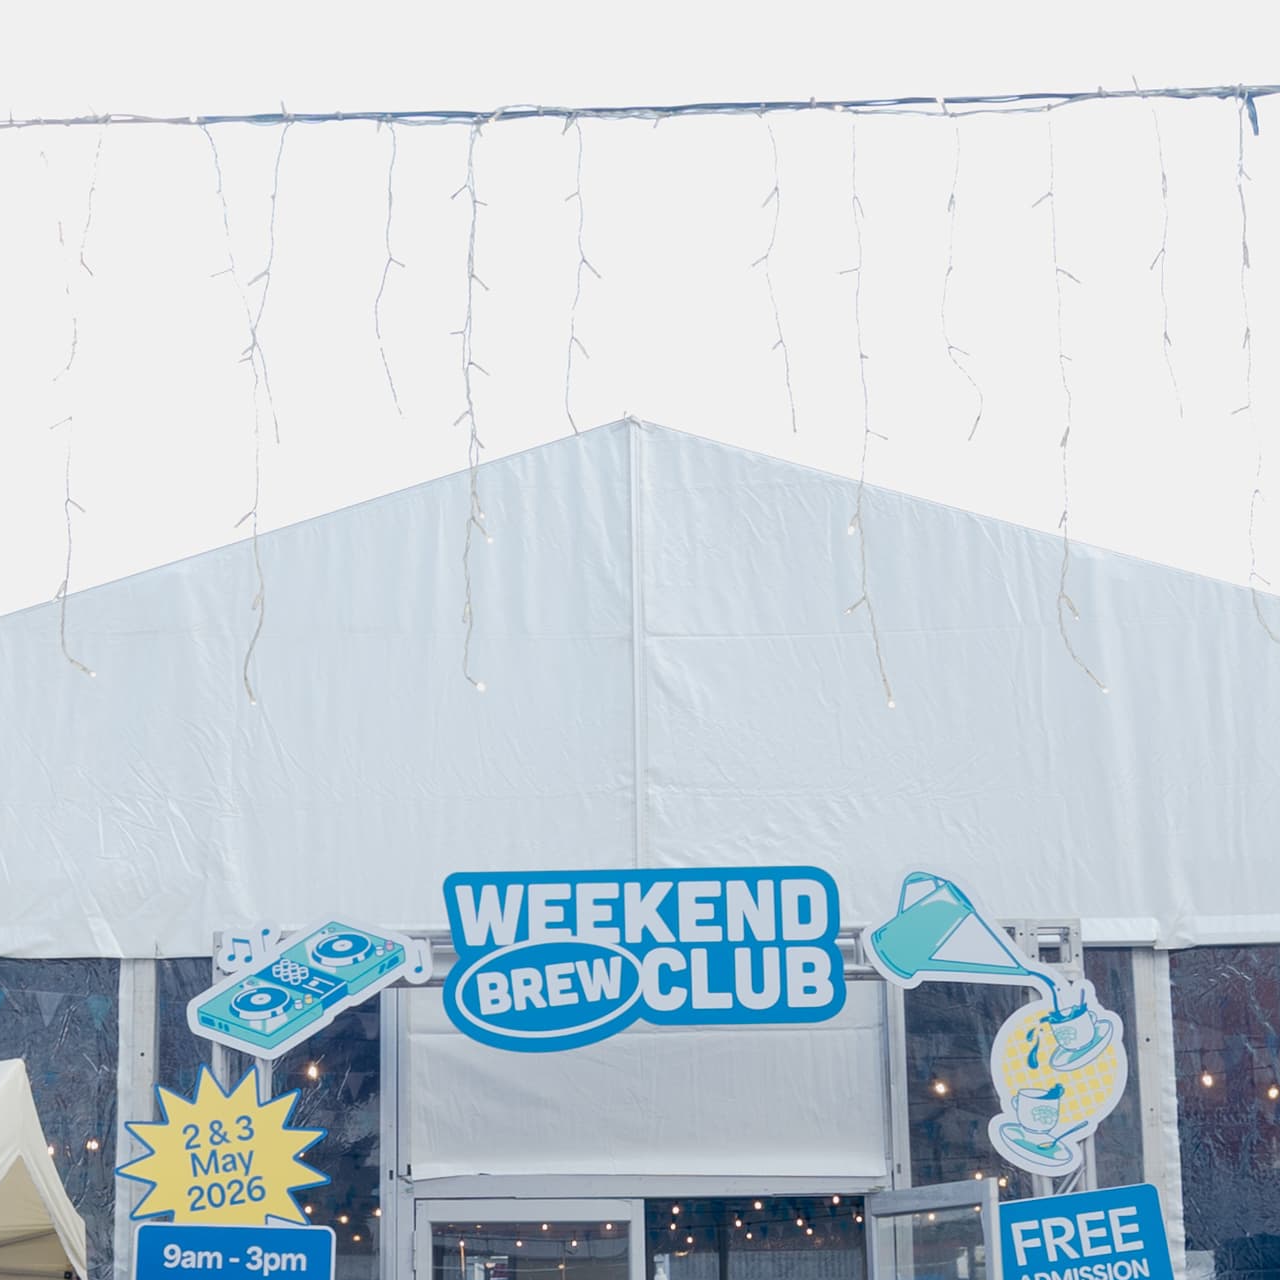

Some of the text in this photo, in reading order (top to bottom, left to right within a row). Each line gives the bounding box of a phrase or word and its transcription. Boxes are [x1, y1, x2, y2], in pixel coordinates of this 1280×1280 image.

[454, 878, 826, 946] WEEKEND
[475, 946, 835, 1016] BREW CLUB
[182, 1114, 255, 1151] 2 & 3
[190, 1149, 255, 1178] May
[187, 1175, 267, 1213] 2026
[1010, 1206, 1145, 1266] FREE
[162, 1243, 224, 1270] 9am
[245, 1245, 308, 1277] 3pm
